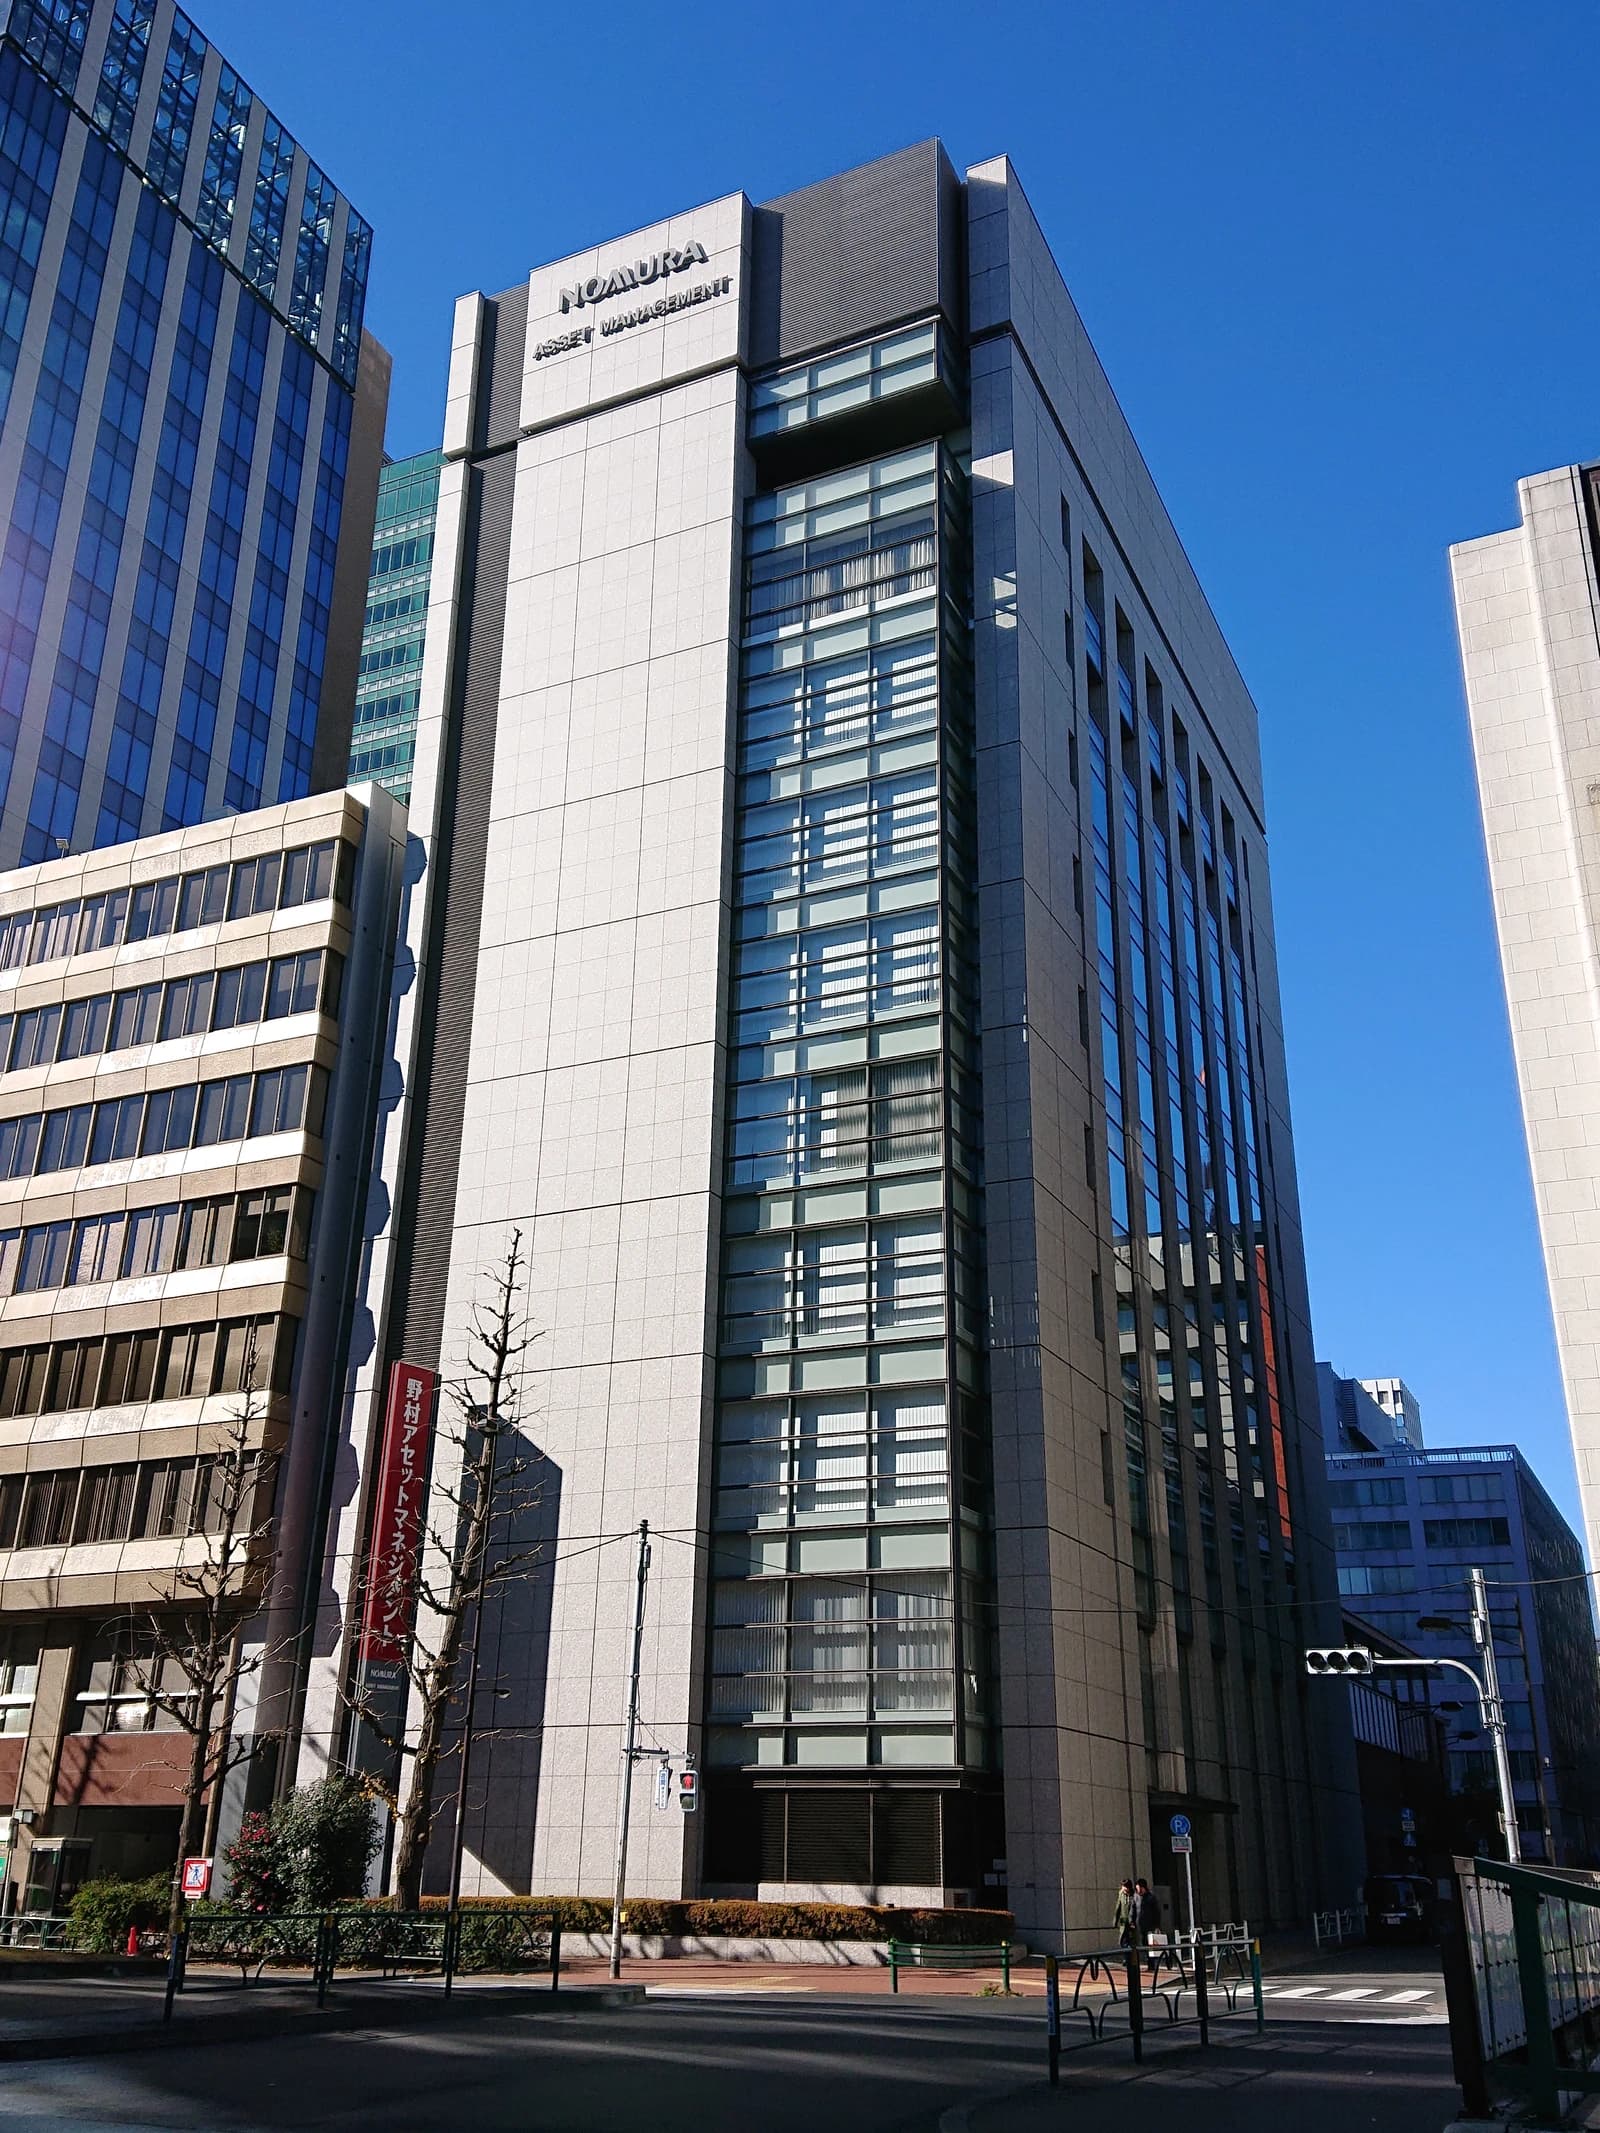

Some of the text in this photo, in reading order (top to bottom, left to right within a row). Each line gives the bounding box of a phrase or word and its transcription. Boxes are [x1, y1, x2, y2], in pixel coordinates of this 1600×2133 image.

[533, 275, 733, 360] ASSET MANAGEMENT
[559, 239, 708, 313] NOMURA
[382, 1377, 423, 1648] 野村アセットマネジメント
